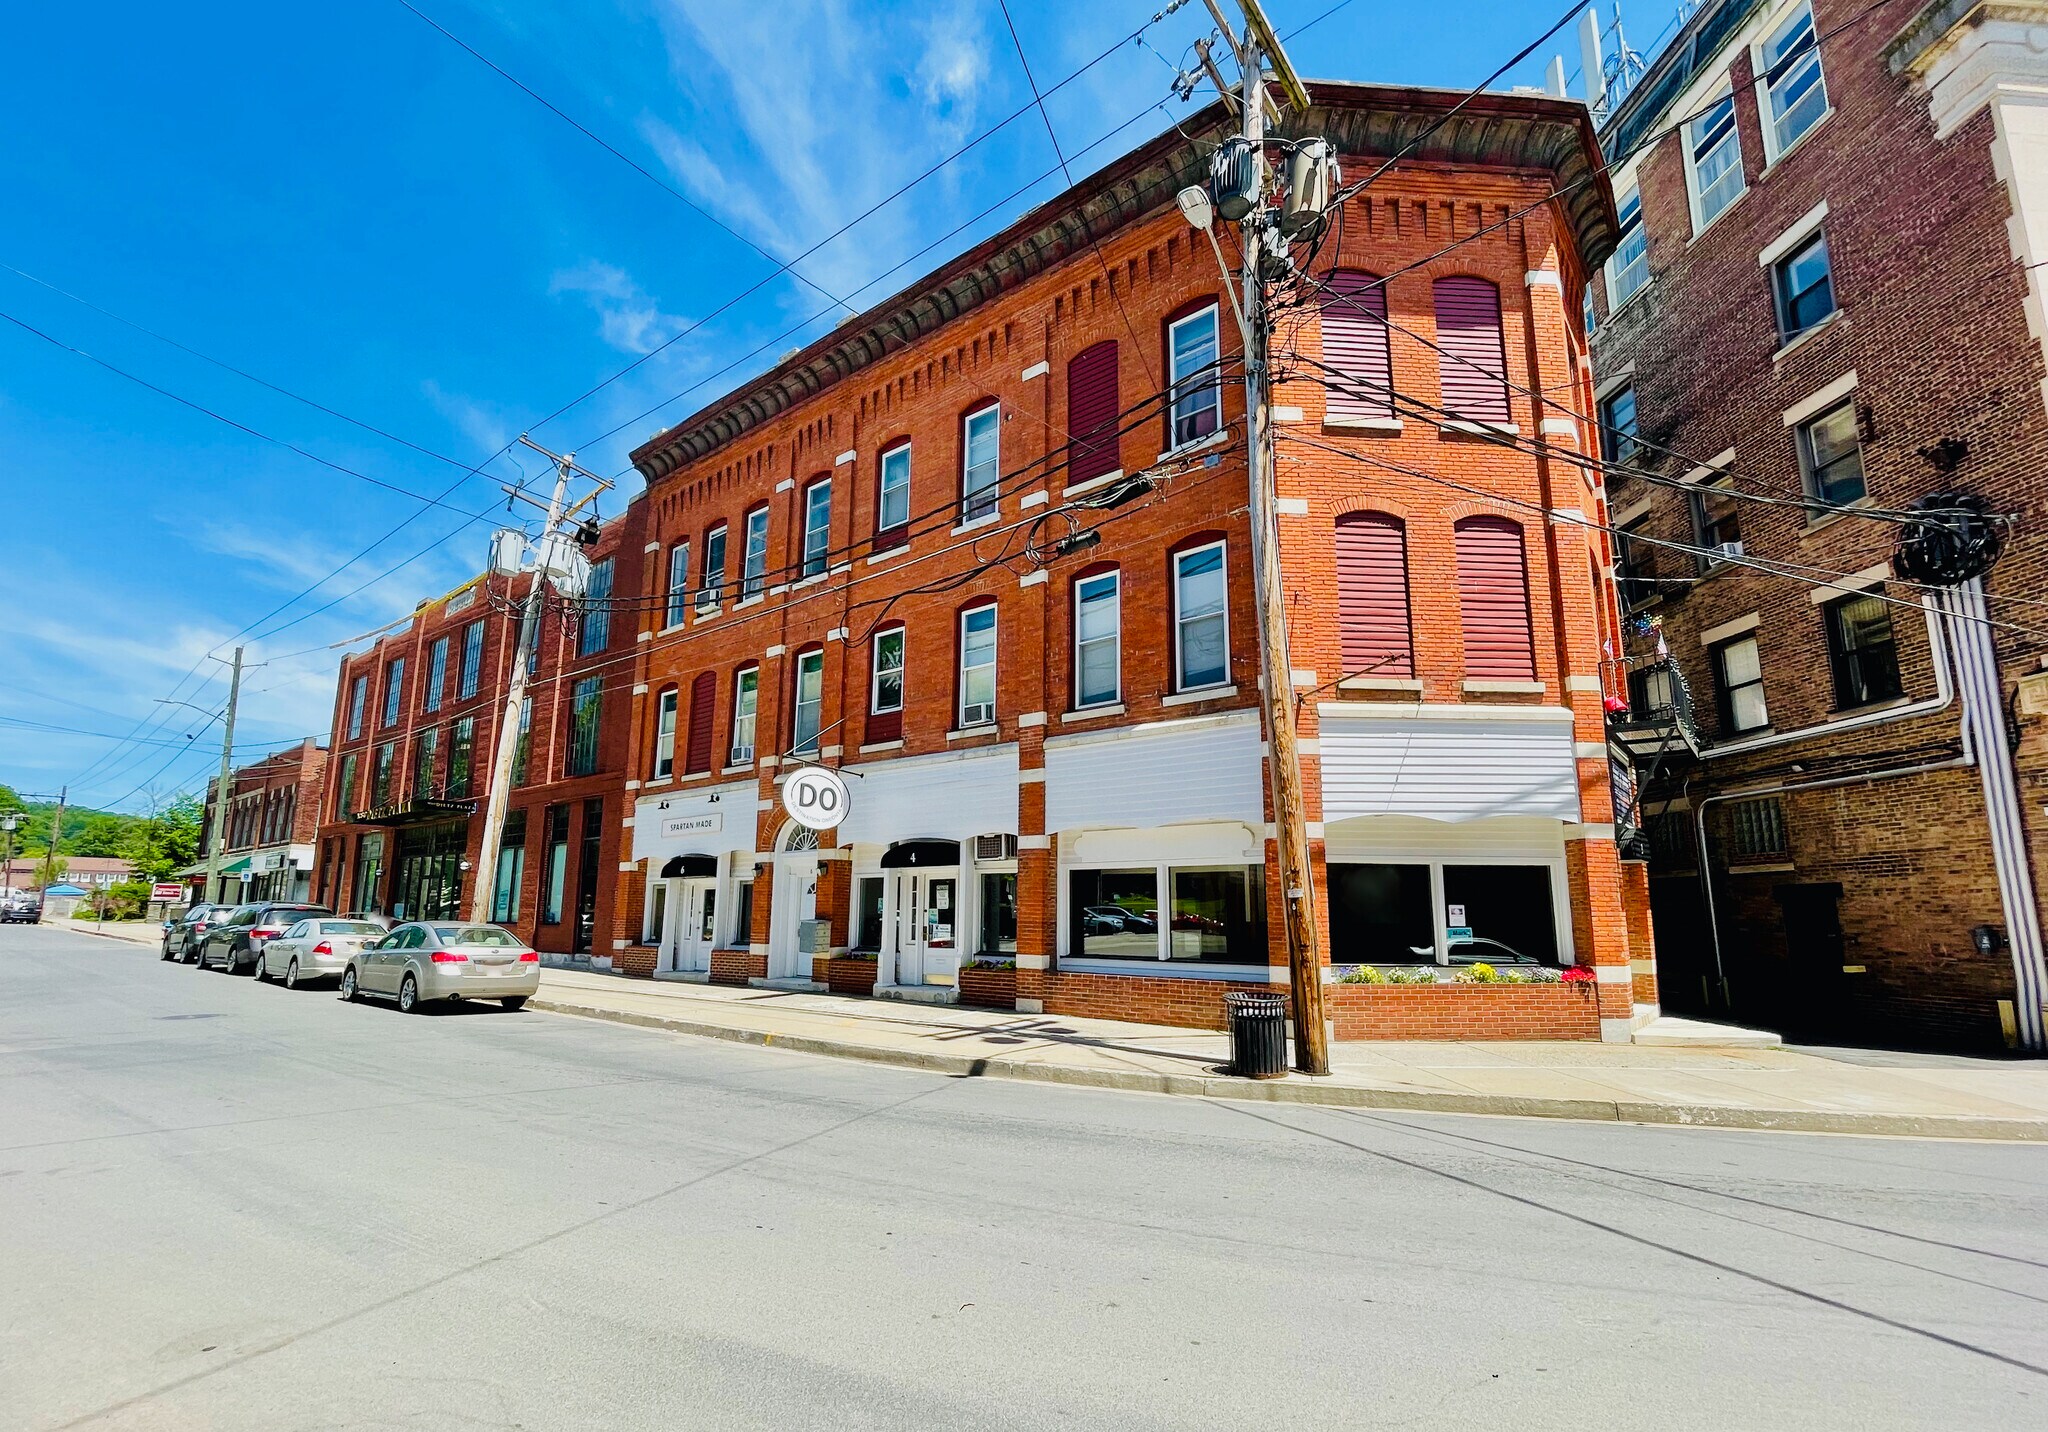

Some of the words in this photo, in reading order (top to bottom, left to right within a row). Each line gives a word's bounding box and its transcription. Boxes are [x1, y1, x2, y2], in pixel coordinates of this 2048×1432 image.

[799, 783, 837, 811] DO
[670, 822, 694, 831] SPARTAN
[695, 820, 712, 828] MADE
[909, 852, 916, 863] 4
[680, 865, 685, 875] 6
